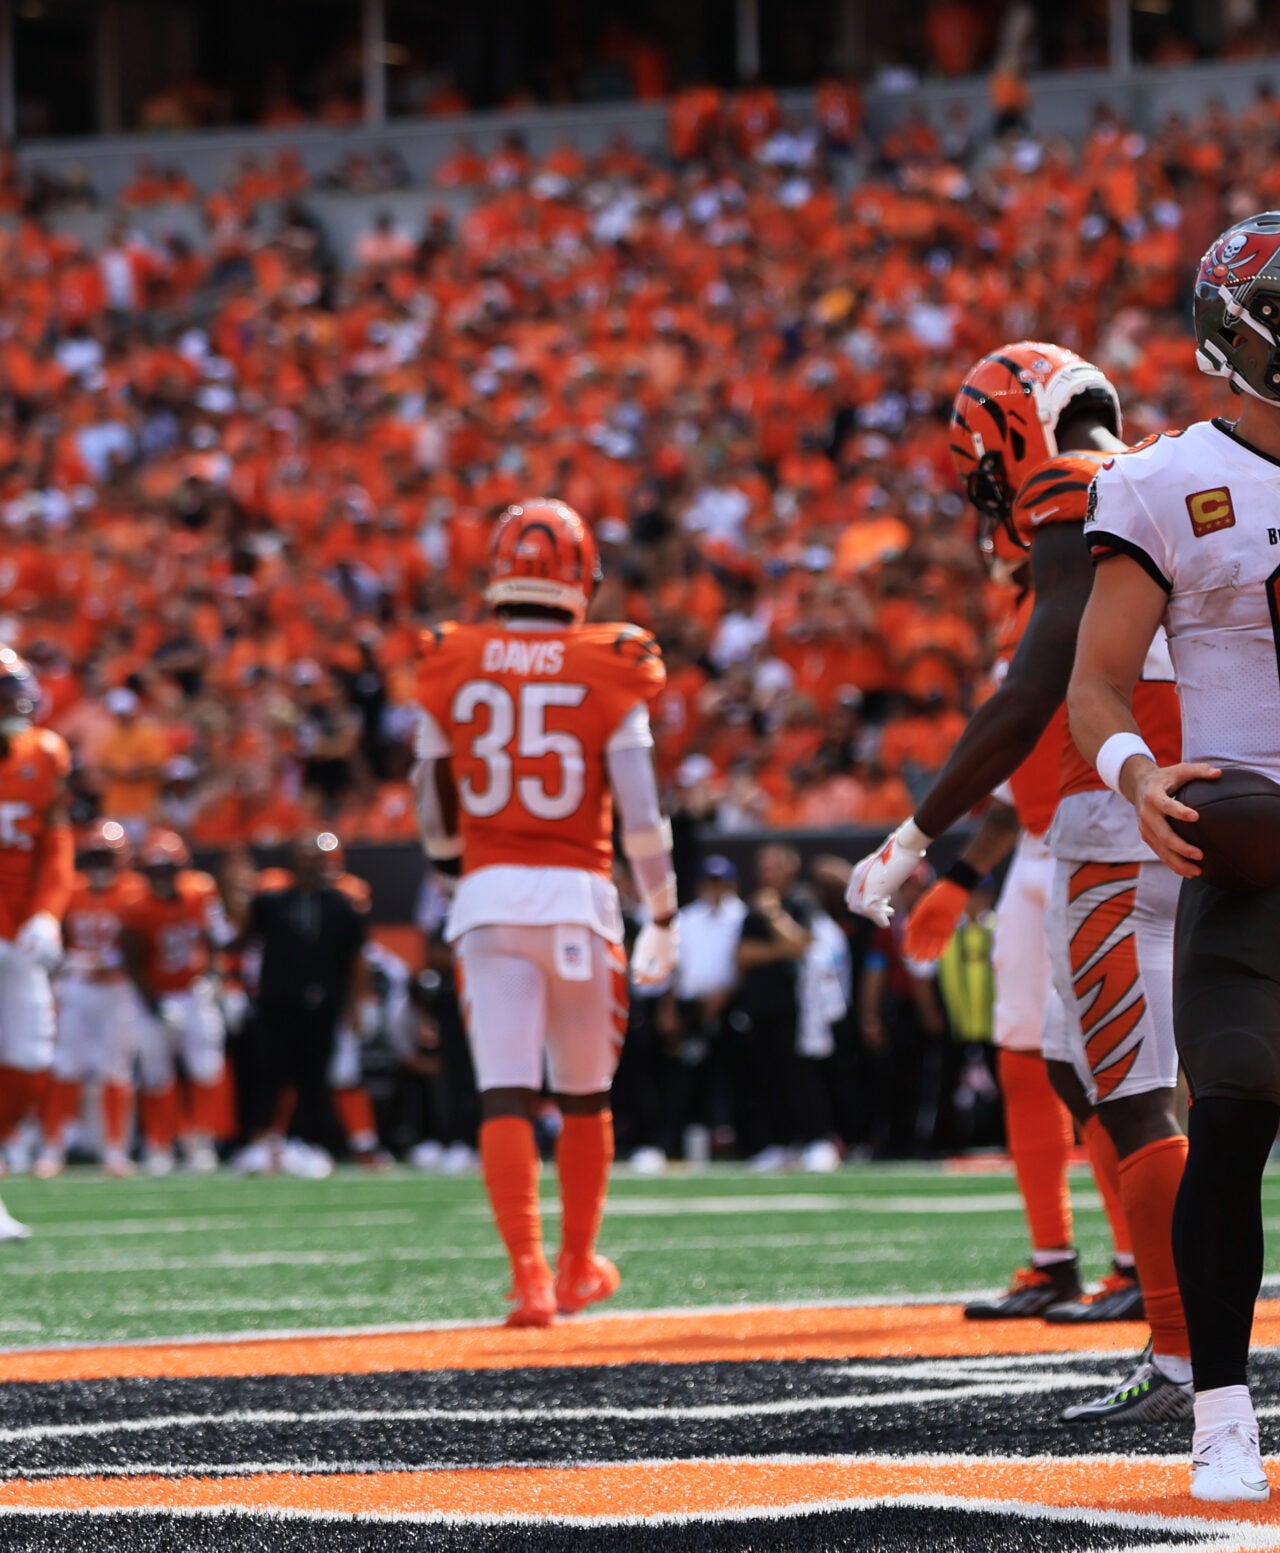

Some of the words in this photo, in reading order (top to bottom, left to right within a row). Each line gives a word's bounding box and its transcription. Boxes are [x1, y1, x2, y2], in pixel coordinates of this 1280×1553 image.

[1191, 490, 1230, 524] C
[482, 638, 566, 676] DAVIS
[452, 679, 589, 820] 35
